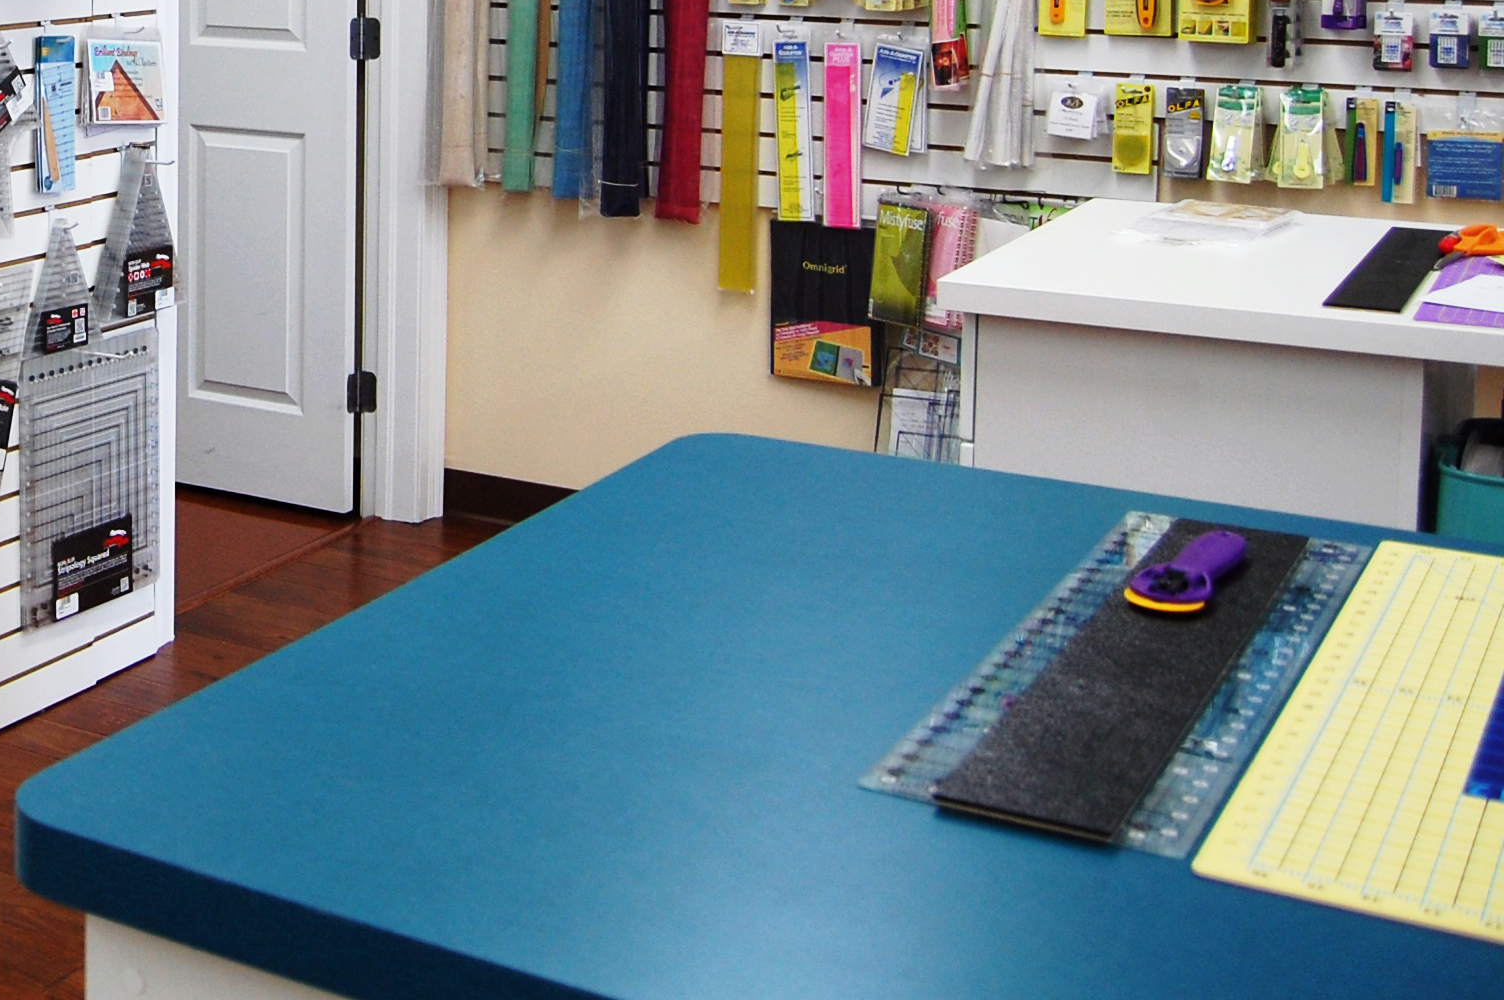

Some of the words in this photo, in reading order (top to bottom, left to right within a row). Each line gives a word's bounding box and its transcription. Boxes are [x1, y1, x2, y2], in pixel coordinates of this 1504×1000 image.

[1115, 94, 1150, 108] OLFA
[1167, 98, 1201, 113] OLFA
[879, 208, 925, 232] Mistyfuse
[802, 260, 846, 275] Omnigrid
